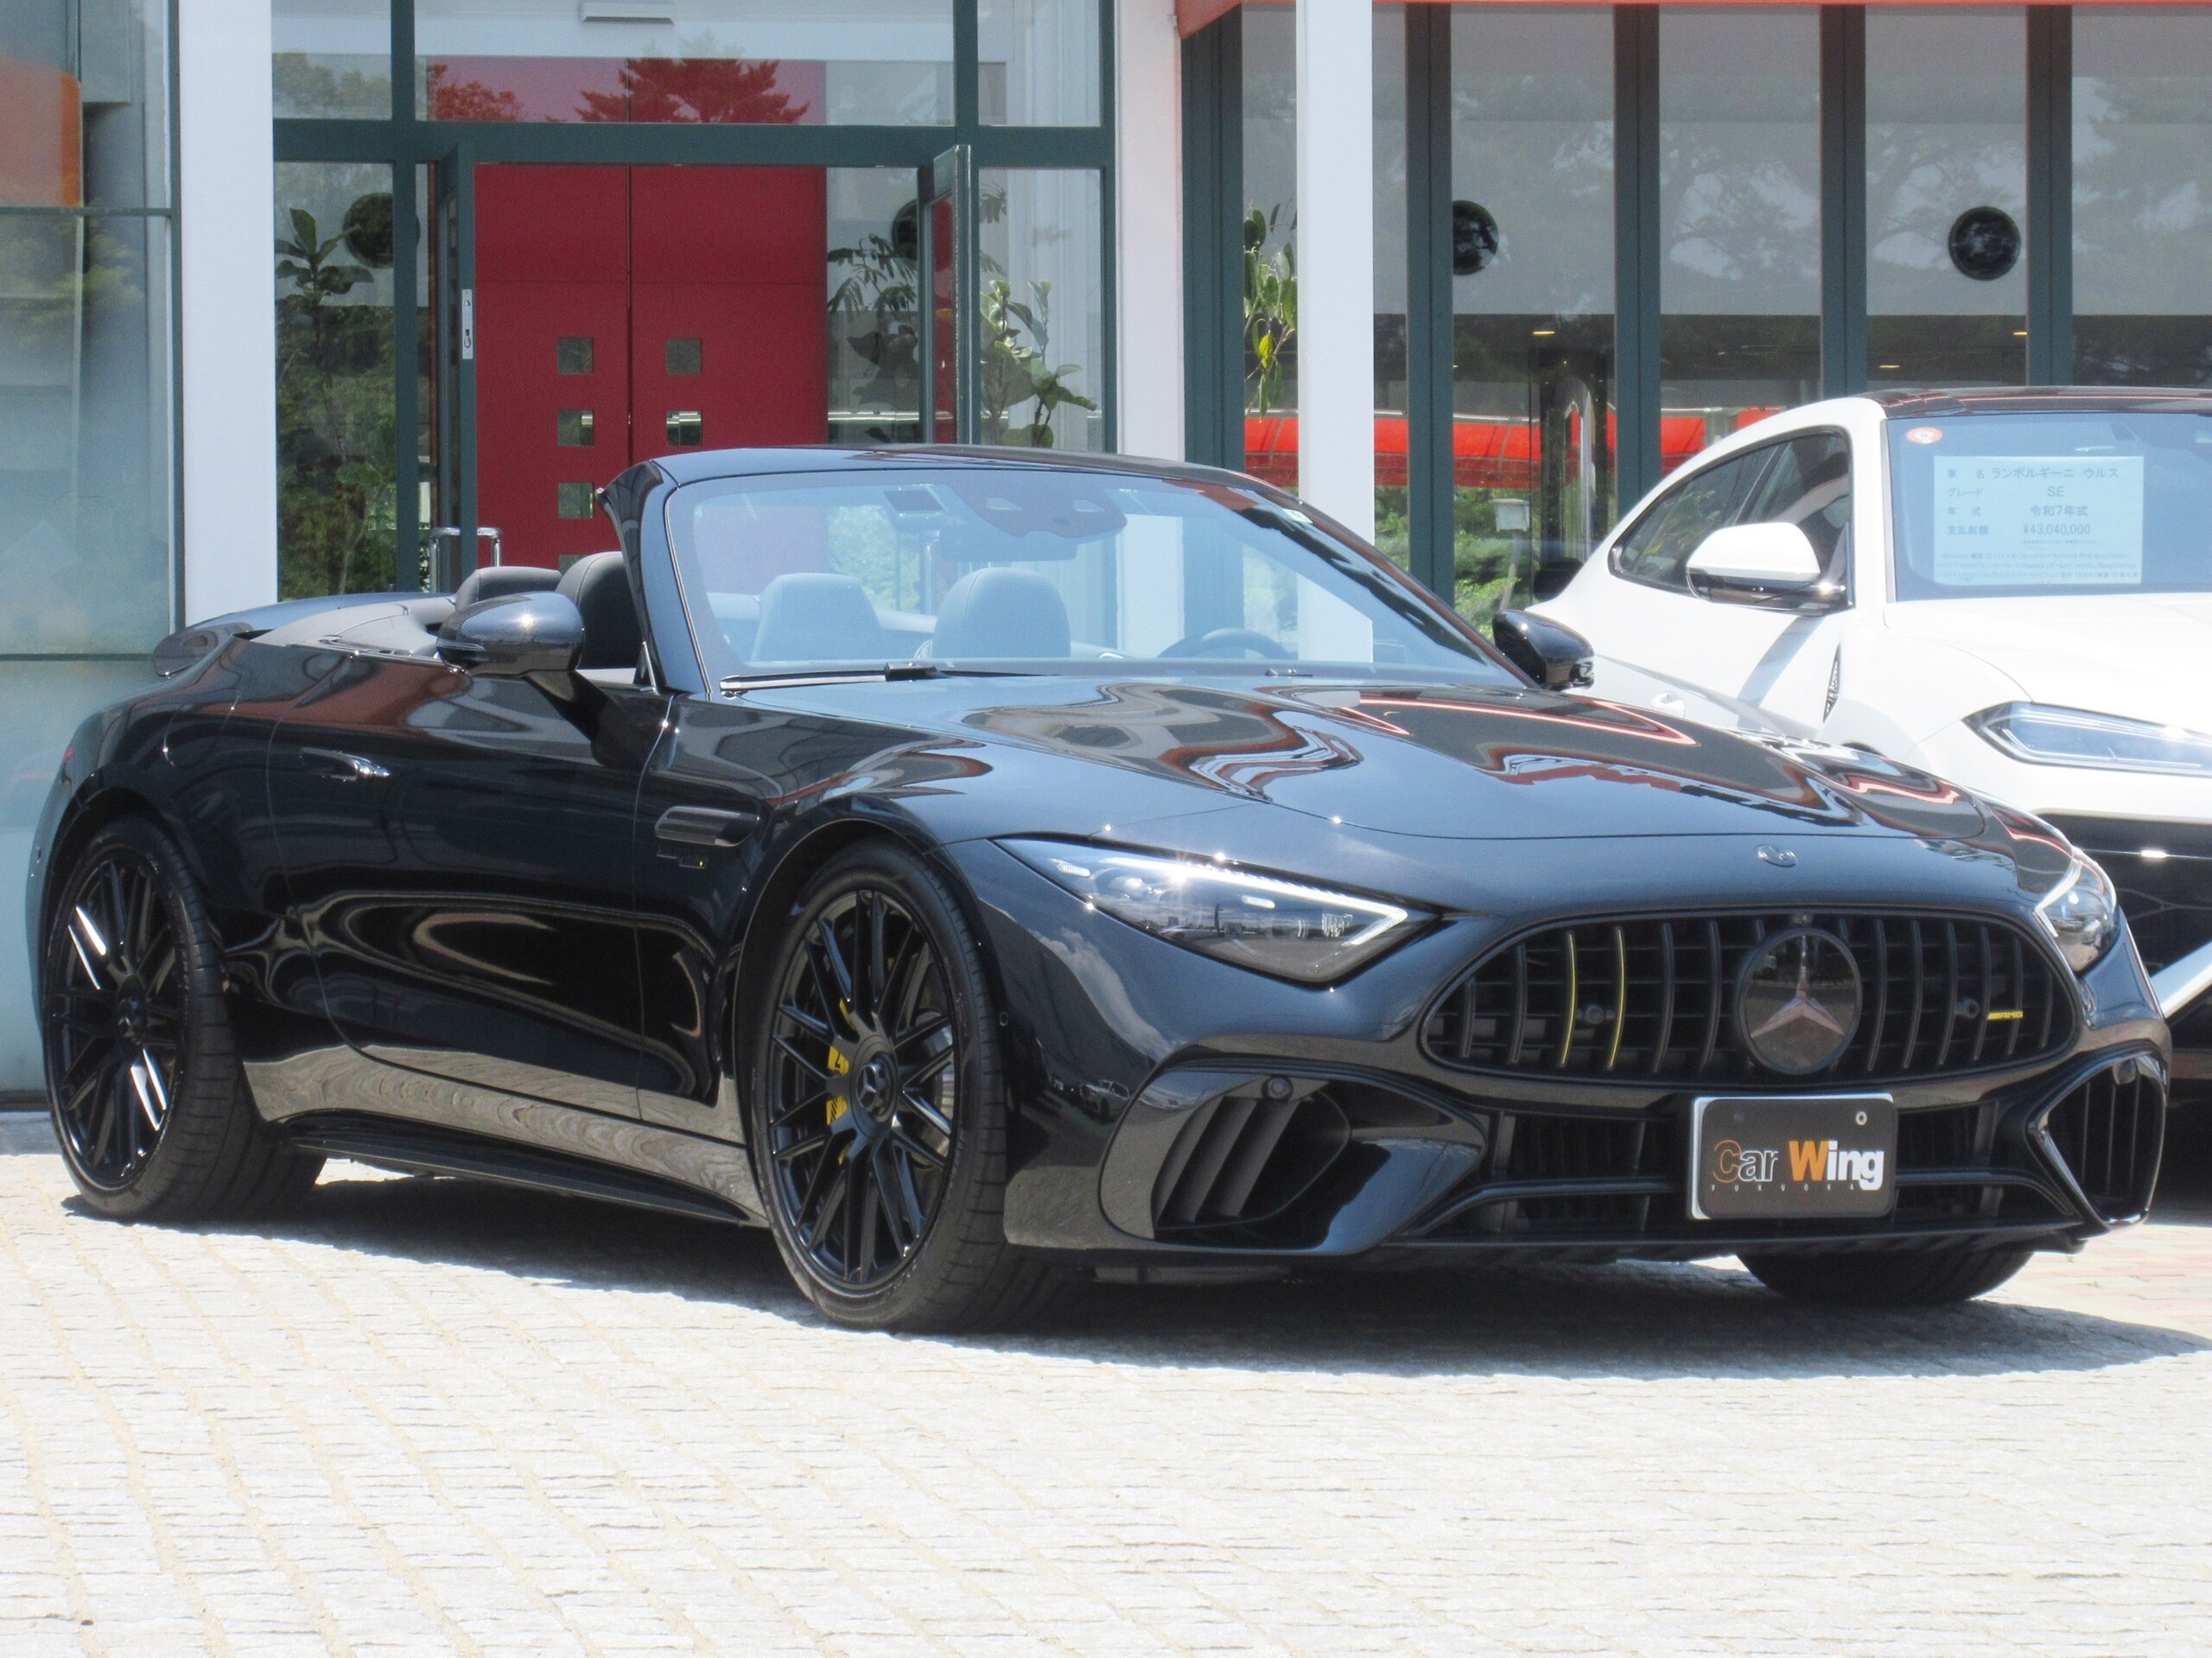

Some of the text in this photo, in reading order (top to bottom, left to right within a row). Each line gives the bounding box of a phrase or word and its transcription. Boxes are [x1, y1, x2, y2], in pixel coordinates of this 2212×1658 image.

[1991, 467, 2075, 479] ランボルギーニ
[2083, 467, 2119, 479] ウルス
[1948, 487, 1984, 498] グレード
[2047, 486, 2065, 498] SE
[2030, 505, 2088, 517] 令和7年式
[1712, 1140, 1885, 1191] Car Wing
